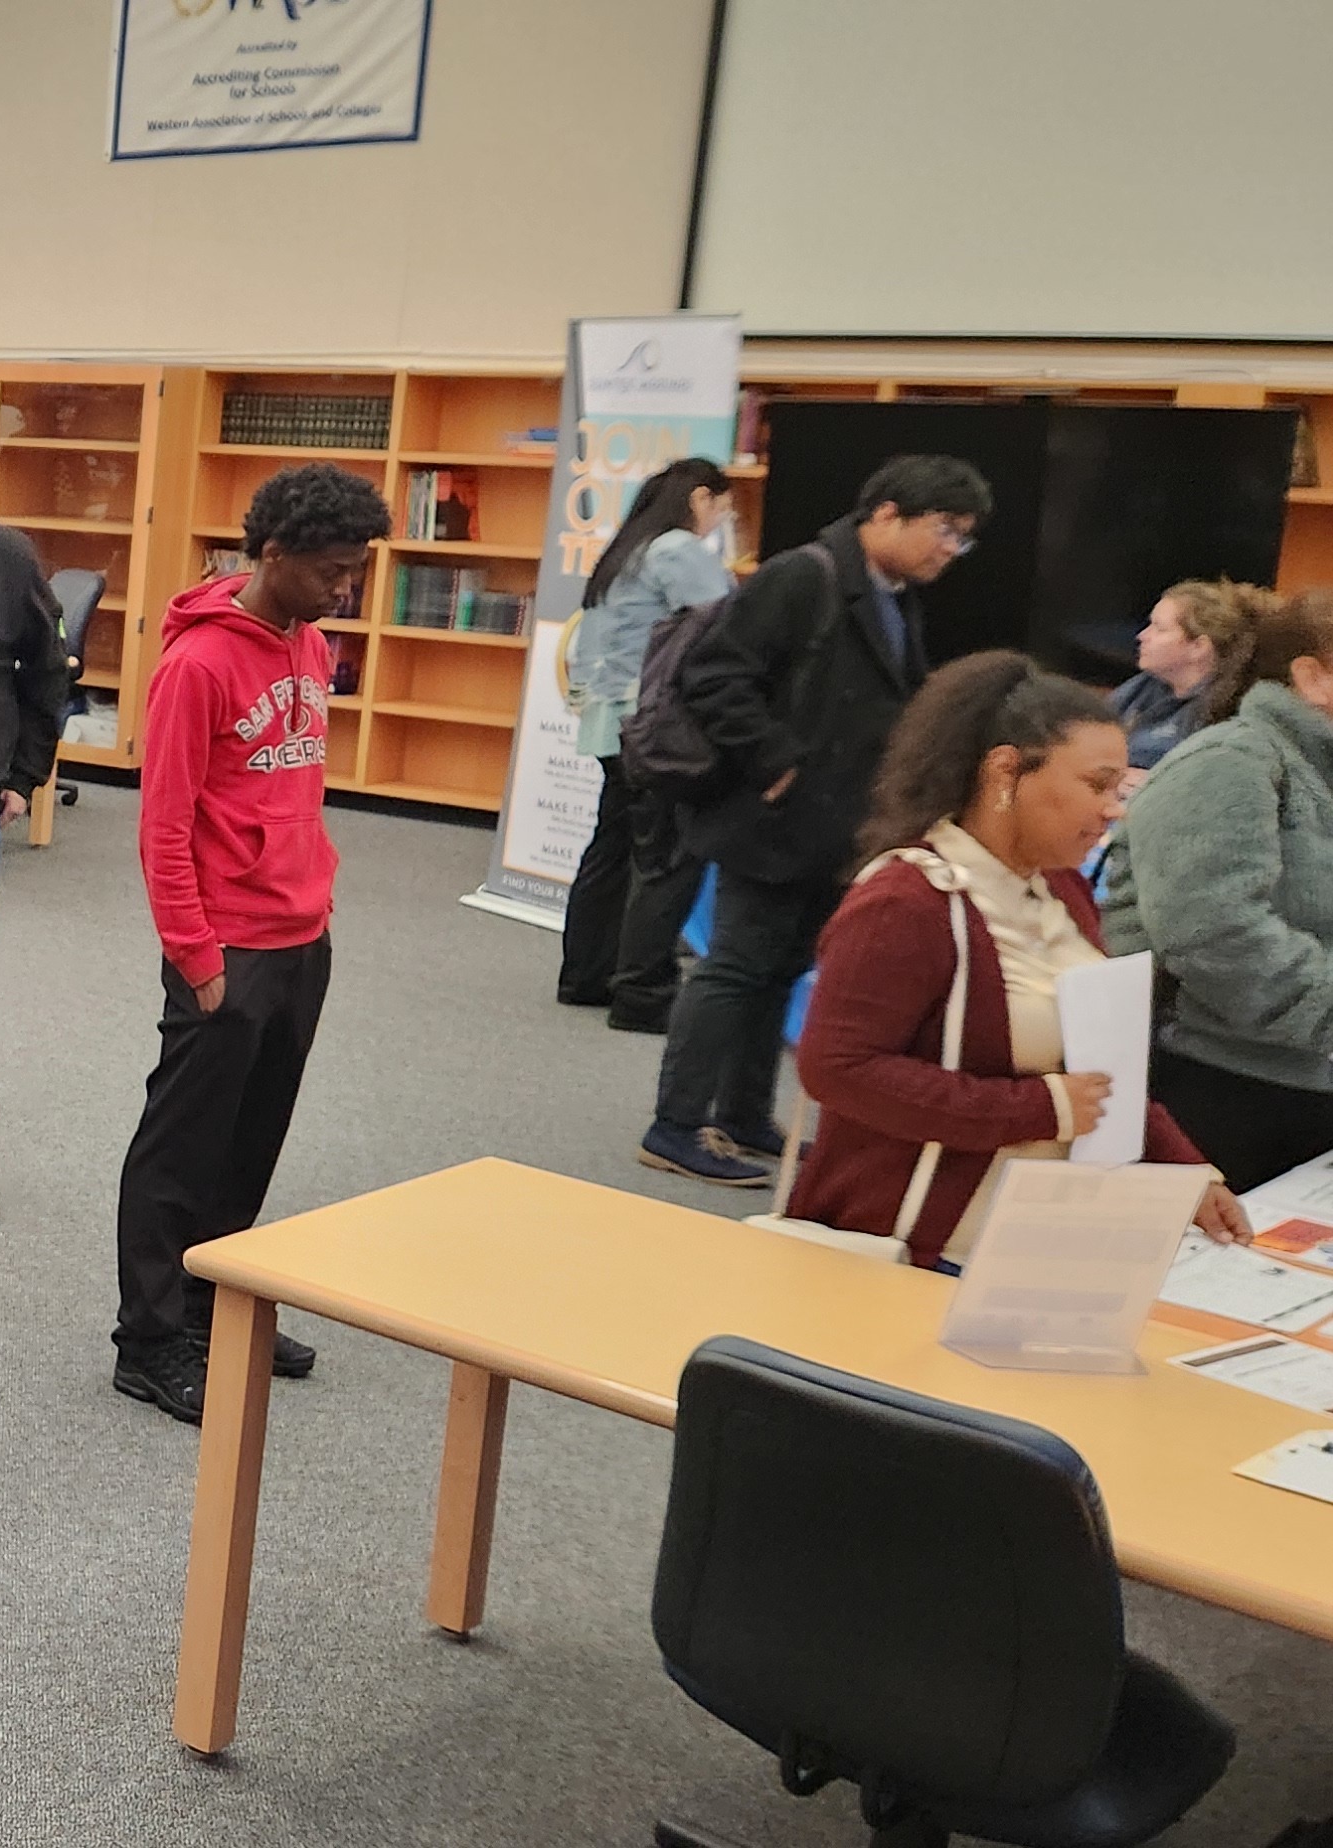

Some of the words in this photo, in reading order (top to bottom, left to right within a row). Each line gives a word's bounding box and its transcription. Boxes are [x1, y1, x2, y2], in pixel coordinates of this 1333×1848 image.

[192, 67, 260, 85] Accrediting
[264, 63, 339, 80] Commission
[230, 86, 247, 99] for
[251, 82, 295, 97] Schools
[147, 118, 189, 131] Western
[192, 113, 251, 128] Association
[267, 108, 307, 122] Schools
[312, 105, 333, 119] and
[539, 720, 571, 736] MAKE
[548, 754, 580, 770] MAKE
[537, 798, 568, 814] MAKE
[542, 843, 573, 859] MAKE
[503, 874, 525, 891] FIND
[527, 878, 555, 898] YOUR
